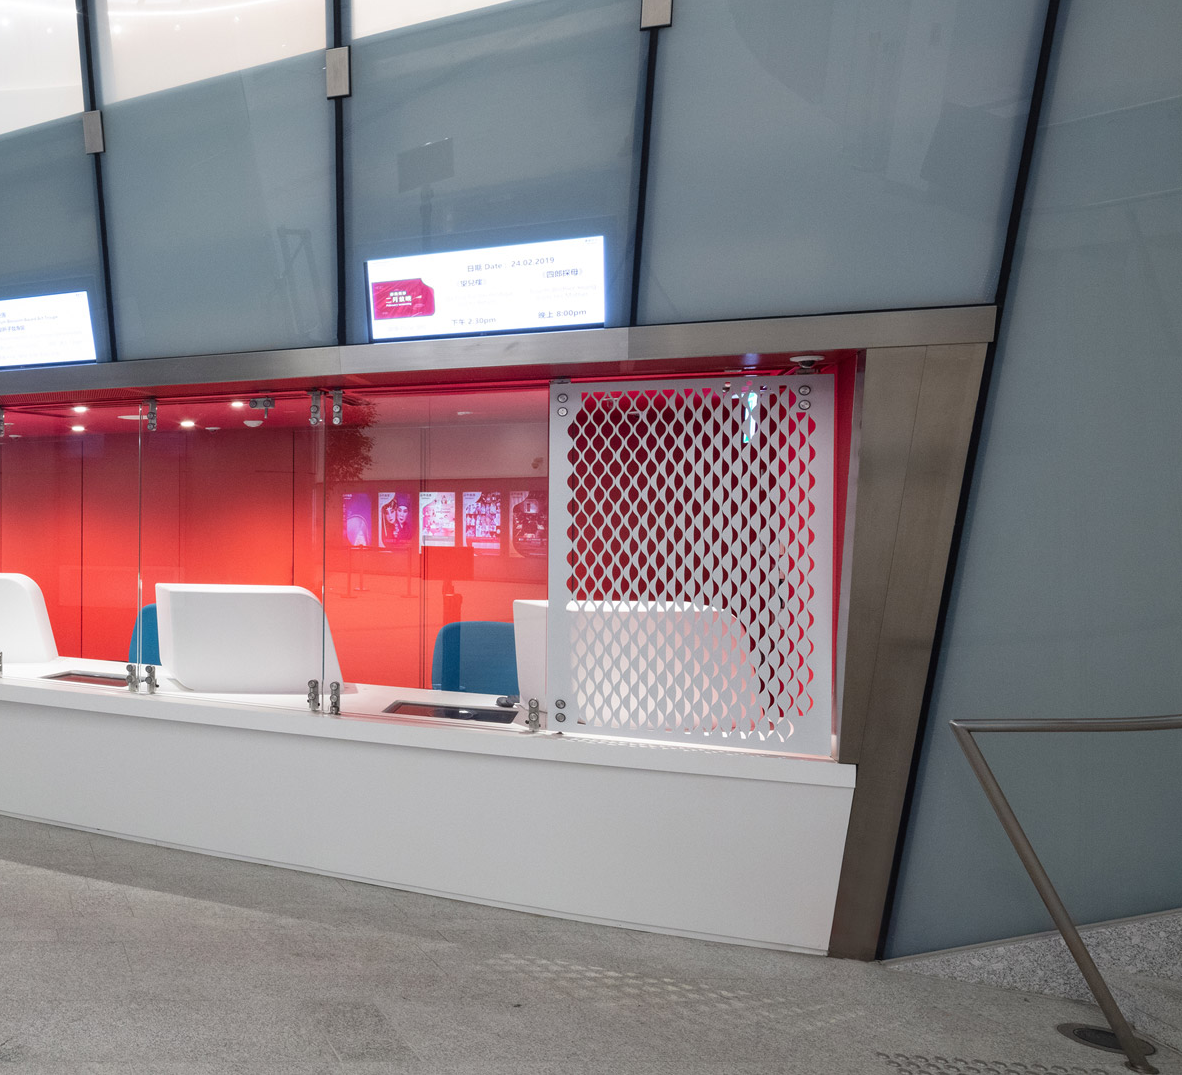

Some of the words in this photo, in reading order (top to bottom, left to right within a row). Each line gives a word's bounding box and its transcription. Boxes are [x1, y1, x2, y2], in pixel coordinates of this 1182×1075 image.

[511, 256, 555, 268] 24.02.2019
[556, 308, 587, 318] 8:00pm
[467, 316, 497, 325] 2:30pm
